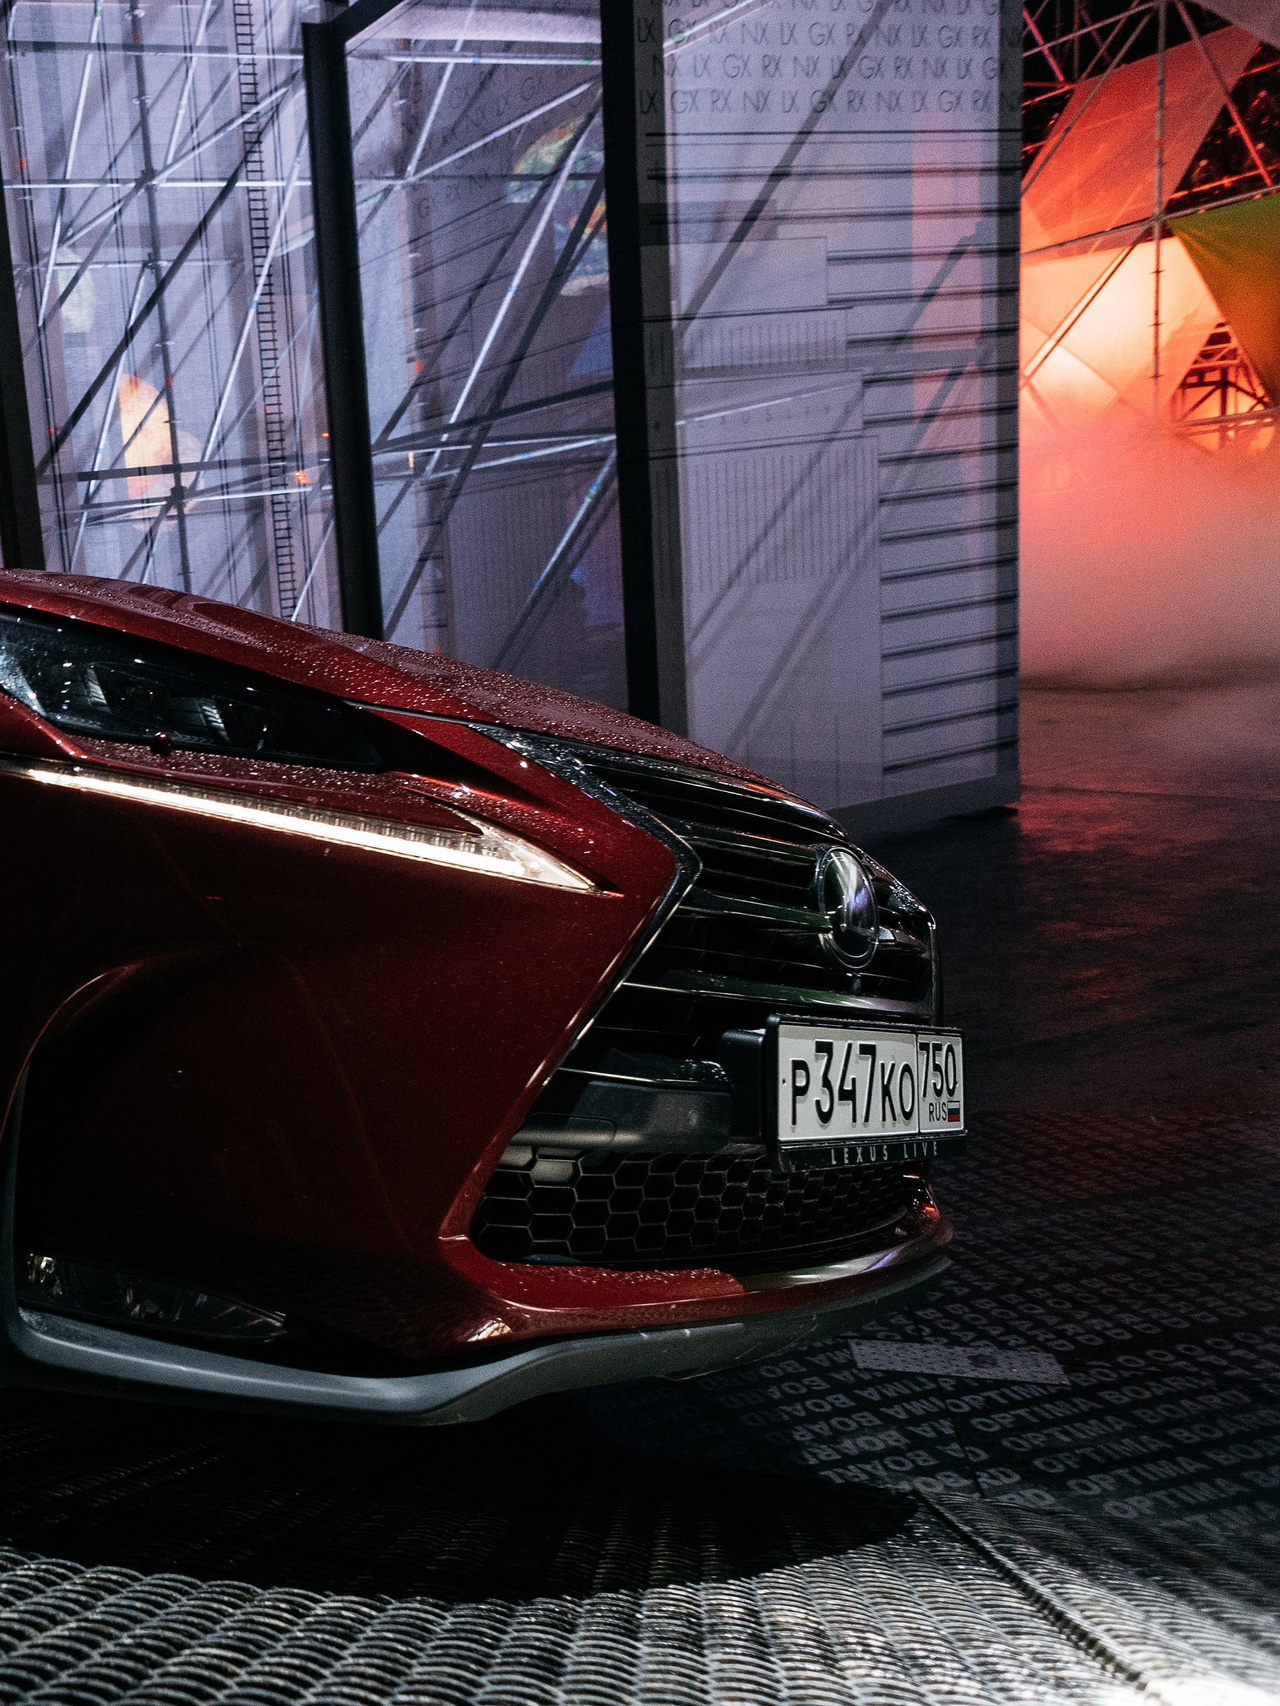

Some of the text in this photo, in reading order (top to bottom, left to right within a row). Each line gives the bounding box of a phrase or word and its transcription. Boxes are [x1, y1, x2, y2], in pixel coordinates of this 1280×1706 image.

[723, 53, 751, 79] GX
[918, 1041, 957, 1098] 750
[928, 1102, 947, 1122] RUS
[831, 1141, 938, 1165] LEXUS LIVE
[970, 1396, 1104, 1433] OPTIMA
[1000, 1414, 1138, 1453] OPTIMA
[1032, 1434, 1174, 1474] OPTIMA
[1066, 1456, 1212, 1497] OPTIMA
[1102, 1477, 1251, 1520] OPTIMA
